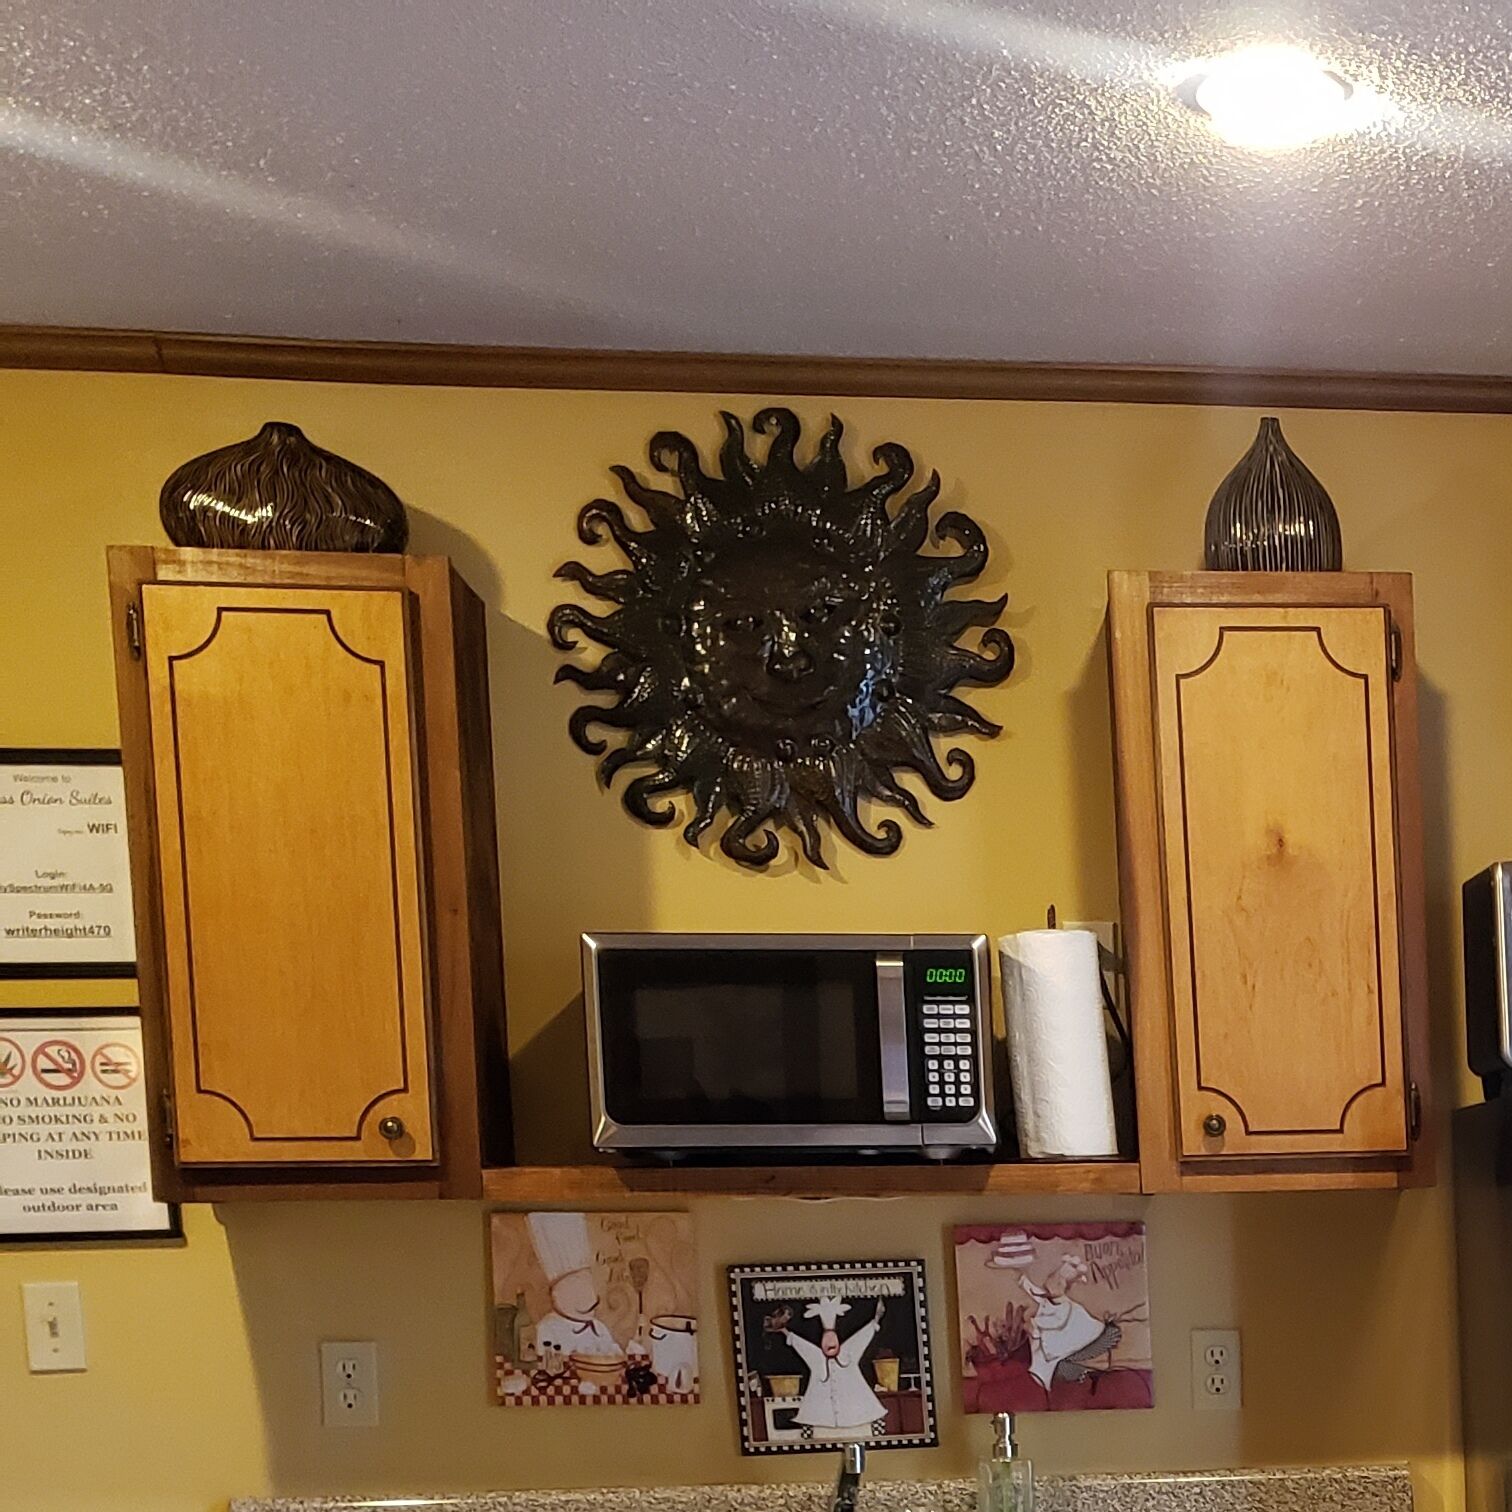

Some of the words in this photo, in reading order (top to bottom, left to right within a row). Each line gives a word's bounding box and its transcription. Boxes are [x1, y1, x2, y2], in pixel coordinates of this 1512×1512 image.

[13, 774, 58, 784] Welcome
[61, 774, 72, 784] to
[21, 790, 65, 806] Onion
[69, 789, 113, 806] Suites
[87, 822, 118, 834] WIFI
[25, 1095, 123, 1108] MARIJUANA
[17, 1113, 95, 1126] SMOKING
[98, 1113, 110, 1125] &
[114, 1112, 137, 1125] NO
[0, 1132, 41, 1144] PING
[45, 1132, 65, 1143] AT
[69, 1131, 103, 1143] ANY
[106, 1130, 147, 1143] TIME
[37, 1149, 94, 1161] INSIDE
[40, 1186, 64, 1196] use
[68, 1181, 147, 1197] designated
[22, 1201, 82, 1214] outdoor
[86, 1202, 119, 1213] area
